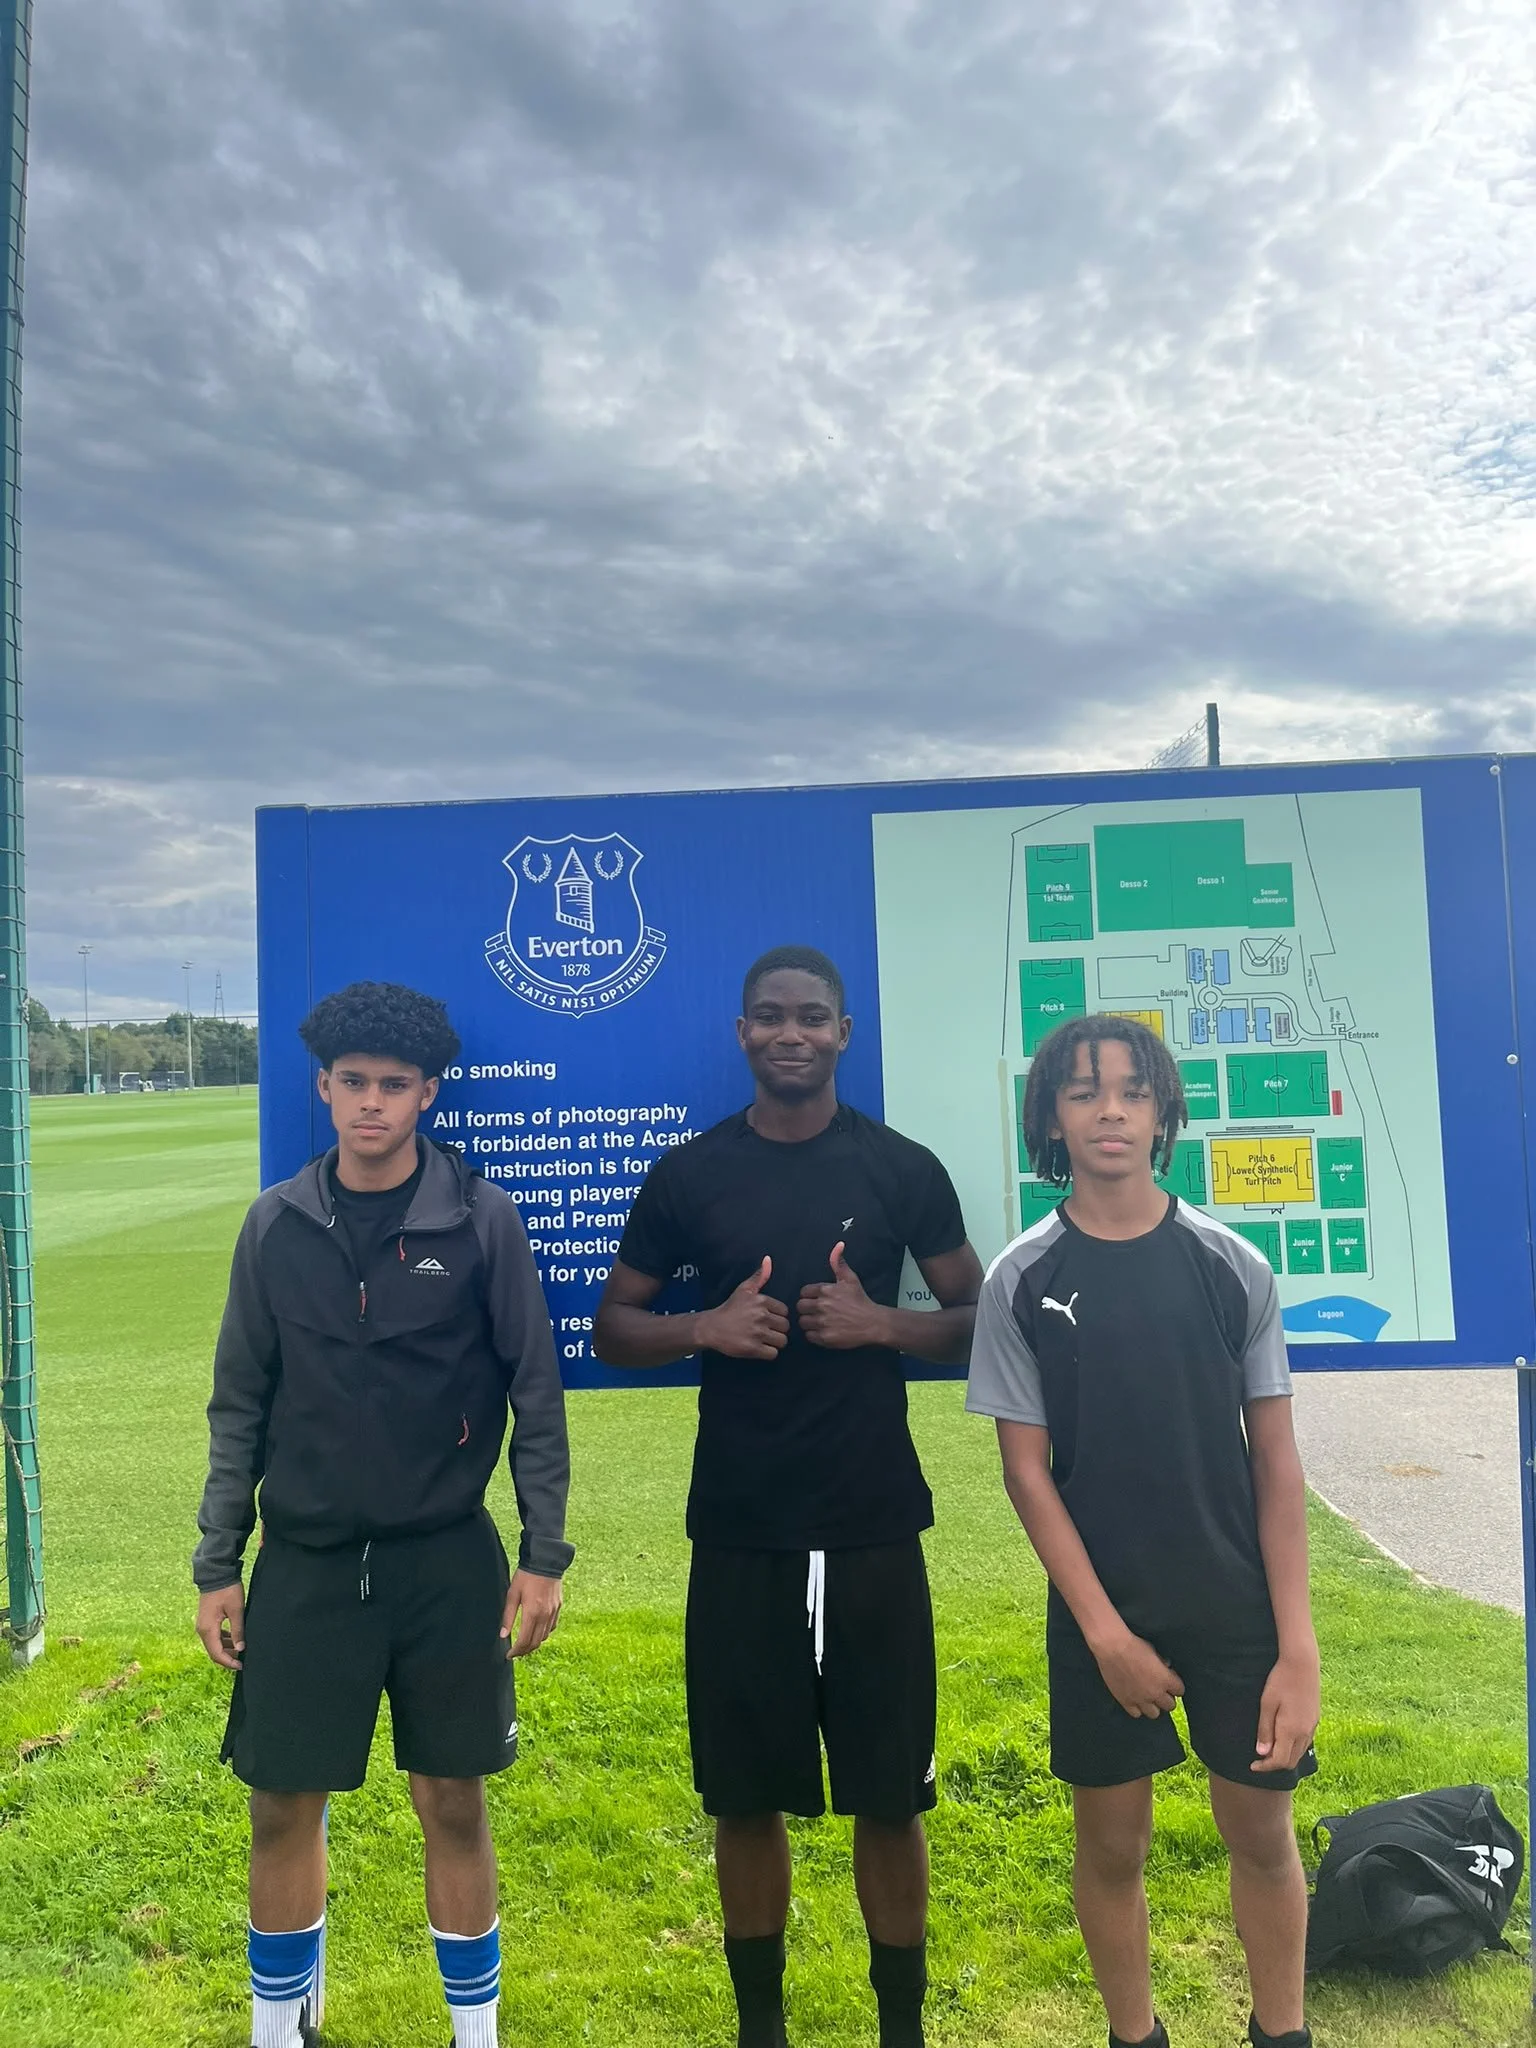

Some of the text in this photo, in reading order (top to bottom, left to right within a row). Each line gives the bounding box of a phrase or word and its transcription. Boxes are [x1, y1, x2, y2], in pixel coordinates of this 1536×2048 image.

[1119, 879, 1149, 889] Desso 2
[1196, 876, 1219, 886] Desso
[1045, 883, 1064, 893] Pitch
[528, 935, 624, 959] Everton
[560, 963, 592, 977] 1878
[496, 953, 657, 1009] NIL SATIS NISI OPTIMUM
[1160, 989, 1189, 998] Building
[1040, 1002, 1059, 1012] Pitch
[1347, 1031, 1380, 1039] Entrance
[470, 1060, 557, 1080] smoking
[1264, 1079, 1289, 1088] Pitch 7
[433, 1103, 688, 1128] All forms of photography
[472, 1133, 572, 1153] forbidden
[578, 1132, 598, 1150] at
[602, 1130, 635, 1148] the
[641, 1128, 703, 1147] Acad
[1248, 1153, 1276, 1163] Pitch 6
[484, 1155, 652, 1179] instruction is for
[1256, 1164, 1293, 1176] Synthetic
[1330, 1163, 1354, 1171] Junior
[1244, 1175, 1283, 1186] Turf Pitch
[1339, 1173, 1346, 1182] C
[527, 1211, 566, 1230] and
[1292, 1237, 1316, 1247] Junior
[1335, 1236, 1358, 1246] Junior
[1301, 1248, 1308, 1257] A
[1344, 1247, 1351, 1256] B
[549, 1264, 578, 1283] for
[583, 1266, 613, 1286] yo
[905, 1291, 932, 1301] YOU
[1317, 1309, 1345, 1320] Lagoon
[560, 1315, 596, 1331] res
[563, 1340, 585, 1359] of
